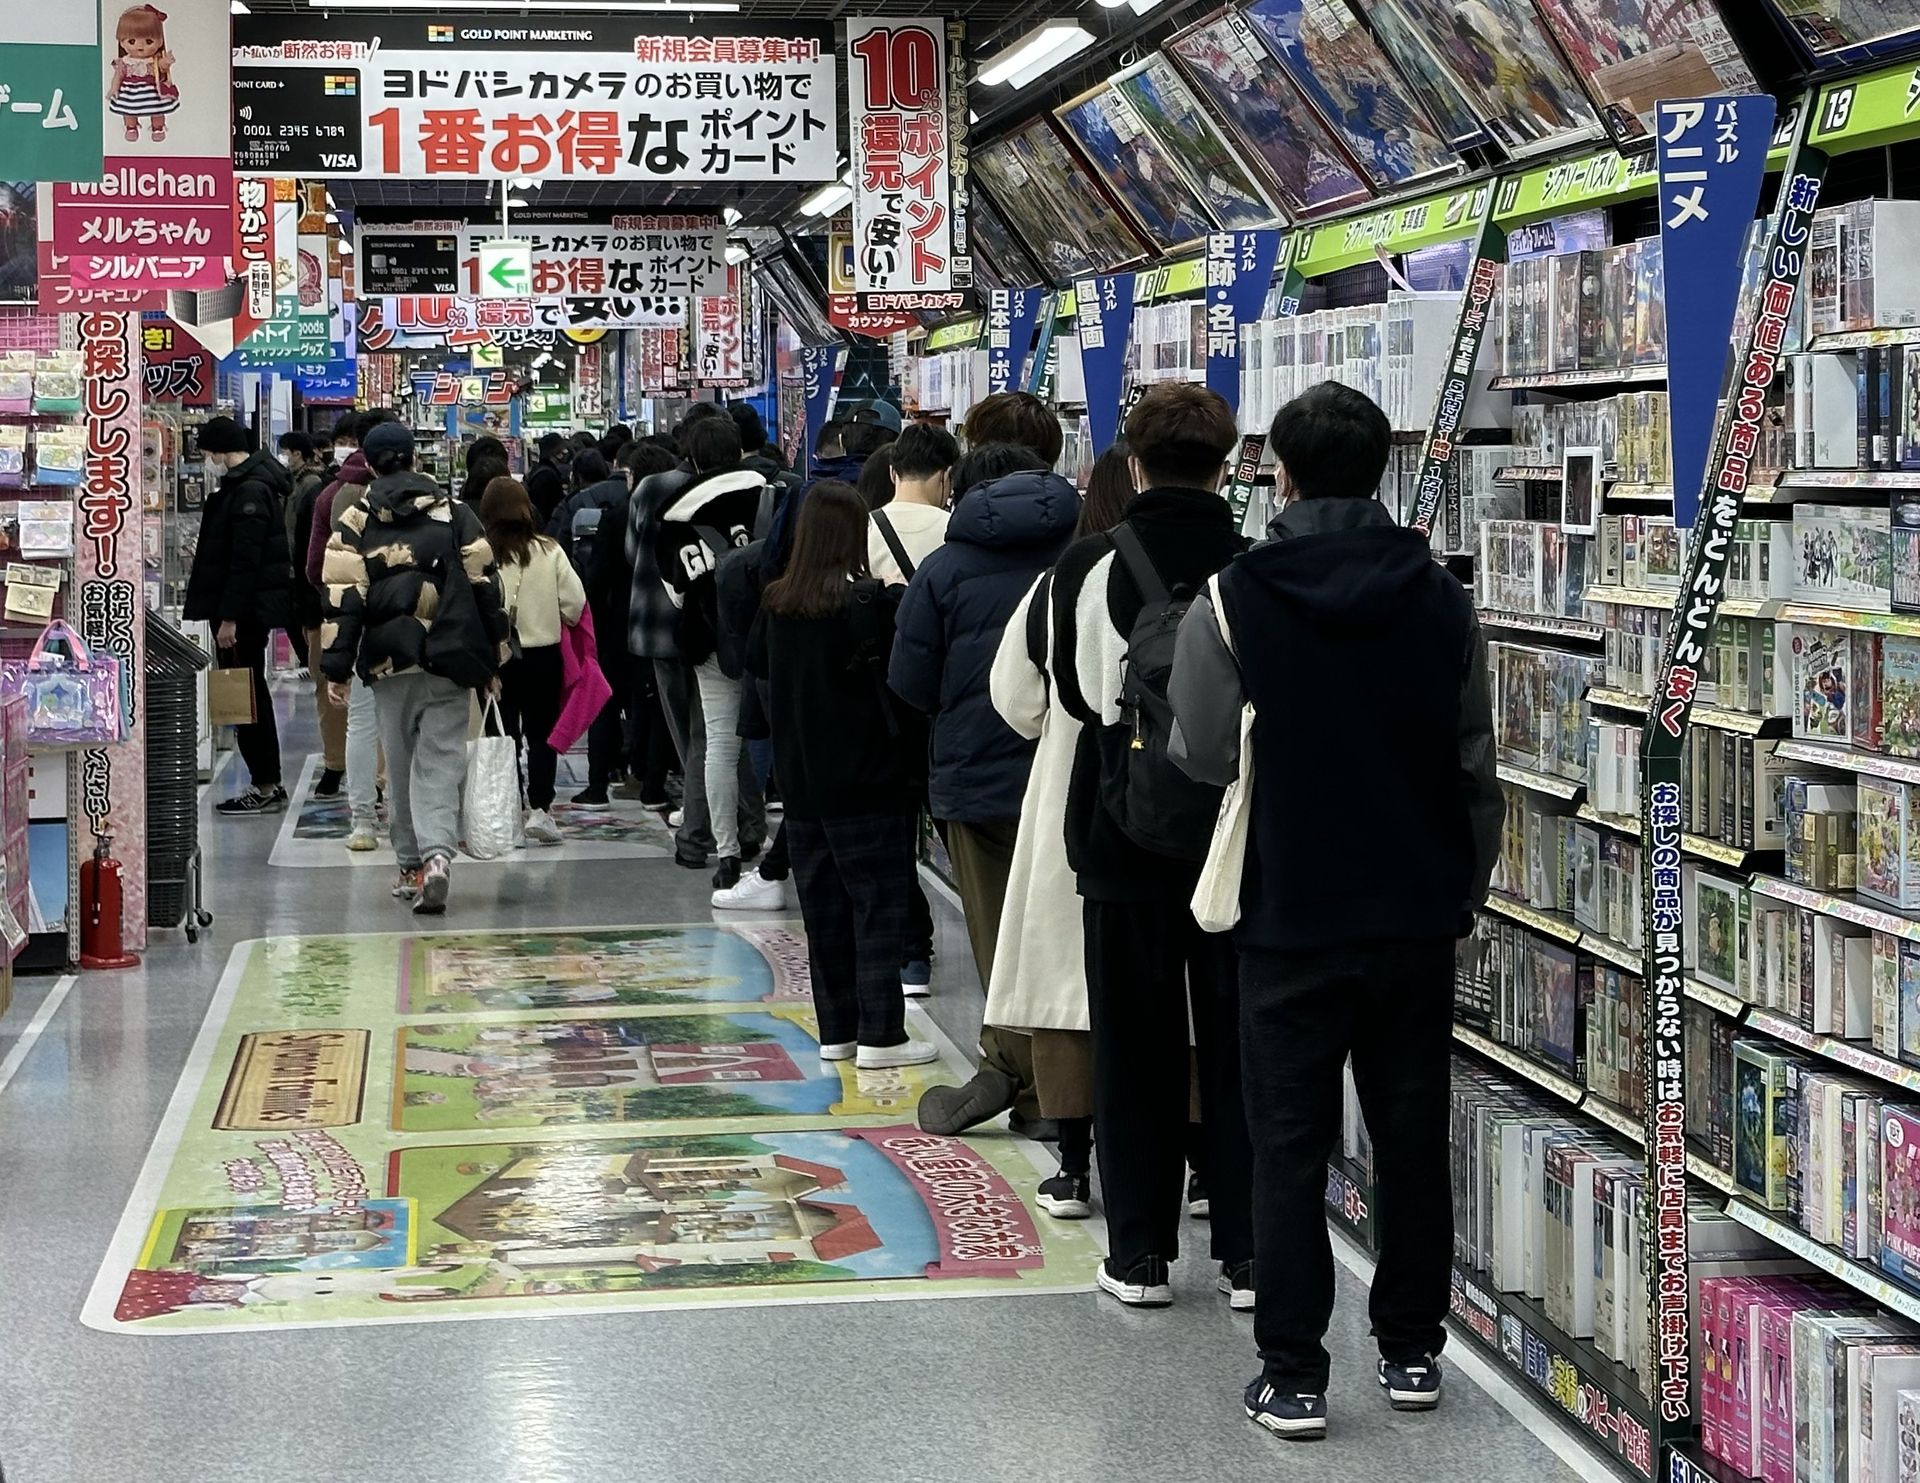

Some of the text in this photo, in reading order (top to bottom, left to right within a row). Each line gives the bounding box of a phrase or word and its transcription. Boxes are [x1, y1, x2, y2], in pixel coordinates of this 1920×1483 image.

[461, 29, 593, 42] GOLD POINT MARKETING
[635, 37, 820, 63] 新規会員募集中!
[255, 81, 277, 89] CARD
[383, 69, 813, 100] ヨドバシカメラのお買い物で
[700, 108, 827, 141] ポイント
[1825, 88, 1853, 130] 13
[244, 125, 345, 137] 0001 2345 6789
[367, 107, 690, 175] 1番お得な
[1714, 100, 1740, 164] パズル
[319, 153, 357, 168] VISA
[700, 142, 797, 175] カード
[1661, 101, 1710, 230] アニメ
[903, 112, 947, 285] ポイント
[1470, 187, 1488, 219] 10
[1502, 180, 1519, 211] 11
[78, 217, 211, 248] メルちゃん
[238, 178, 267, 262] 物かご
[1241, 232, 1257, 272] パズル
[1278, 239, 1287, 263] 8
[1300, 234, 1311, 260] 9
[88, 256, 206, 281] シルバニア
[462, 257, 644, 295] 1お得な
[650, 256, 722, 275] ポイント
[1160, 269, 1169, 291] 7
[434, 283, 456, 292] VISA
[650, 276, 705, 294] カード
[1103, 277, 1118, 311] パズル
[1208, 231, 1237, 358] 史跡・名所
[867, 293, 964, 311] ヨドバシカメラ
[1013, 290, 1025, 319] パズル
[1076, 279, 1106, 350] 風景画
[848, 316, 906, 328] カウンター
[143, 329, 173, 351] き!
[297, 364, 326, 376] トミカ
[804, 348, 820, 399] ジャンプ
[410, 372, 512, 405] ラジン
[1661, 174, 1821, 737] 新しい価値ある商品をどんどん安く
[1651, 782, 1690, 1422] お探しの商品が見つからない時はお気軽に店員までお声掛け下さい
[883, 1136, 1027, 1261] 赤い屋根の大きなお家
